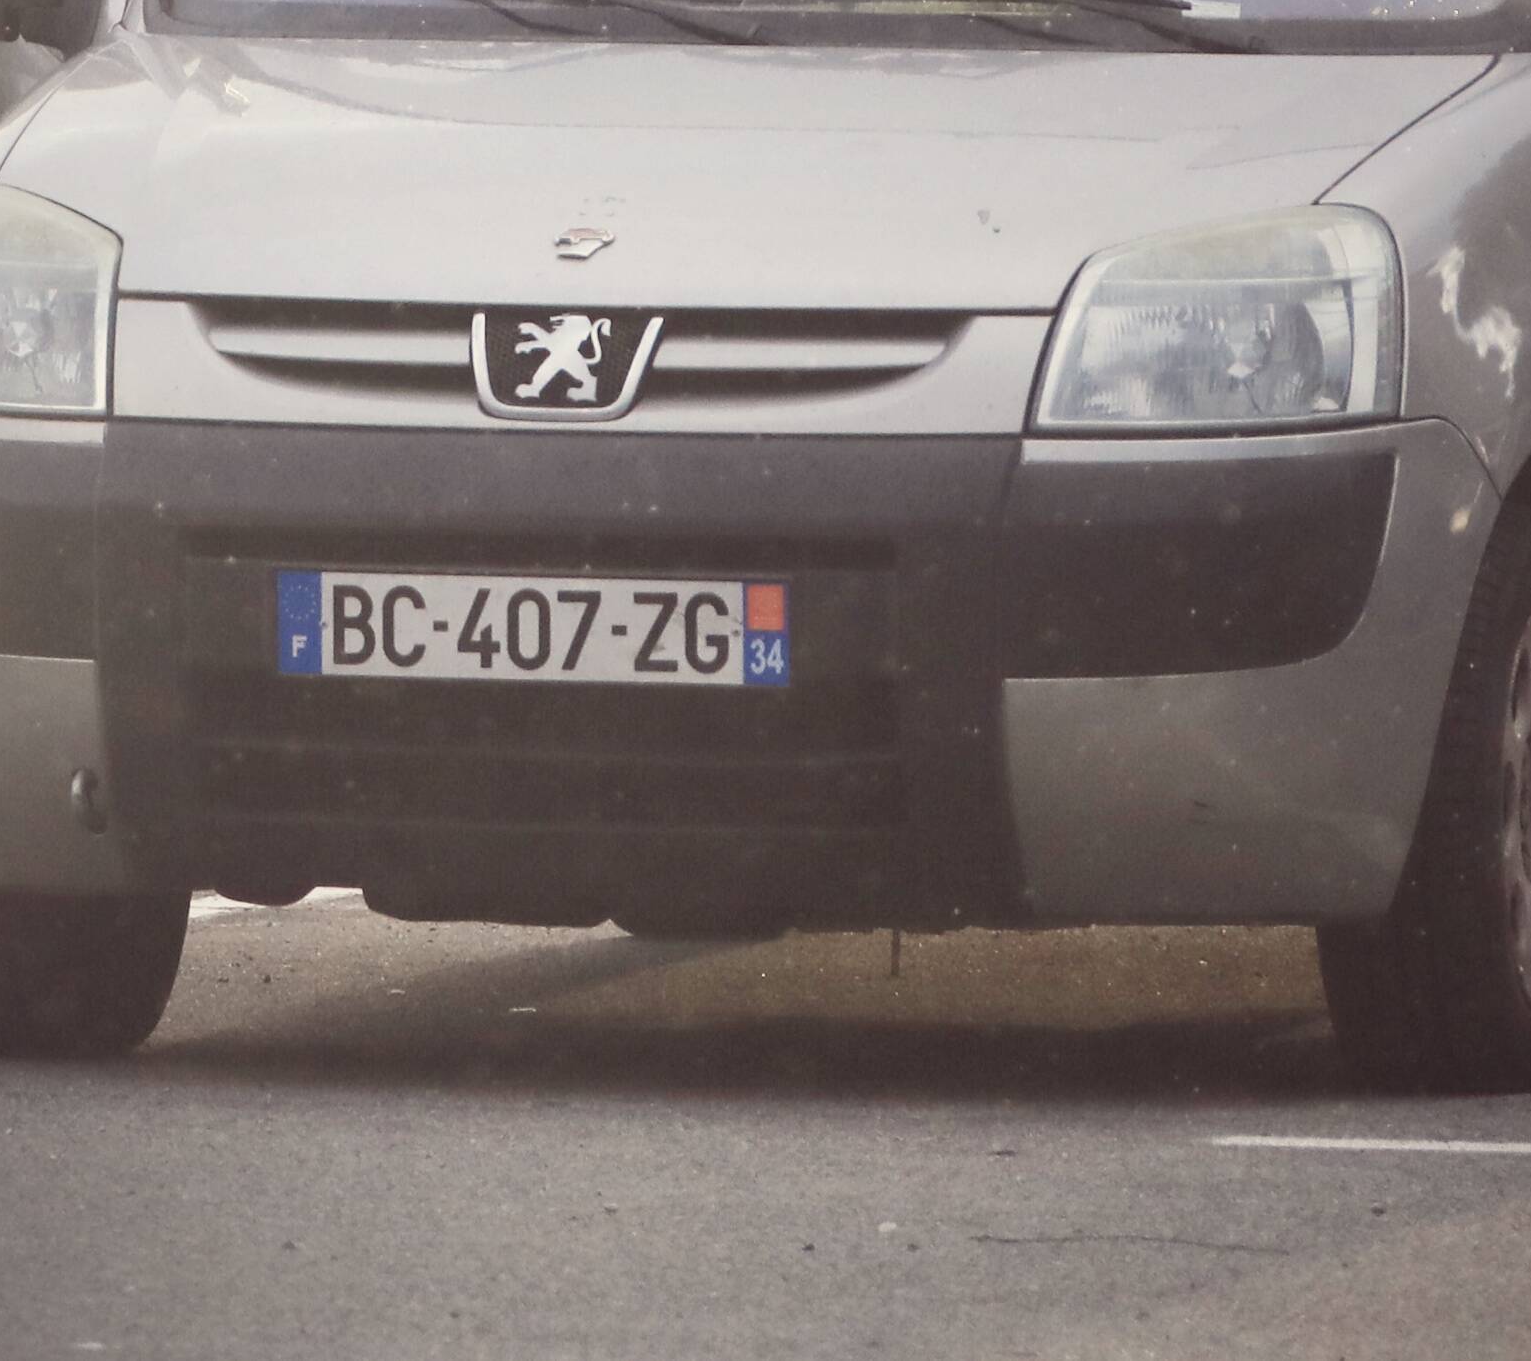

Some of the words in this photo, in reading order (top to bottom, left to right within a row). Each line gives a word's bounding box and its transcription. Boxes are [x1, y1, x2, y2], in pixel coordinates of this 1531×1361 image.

[291, 634, 307, 658] F
[331, 584, 730, 674] BC-407-ZG
[750, 638, 785, 675] 34
